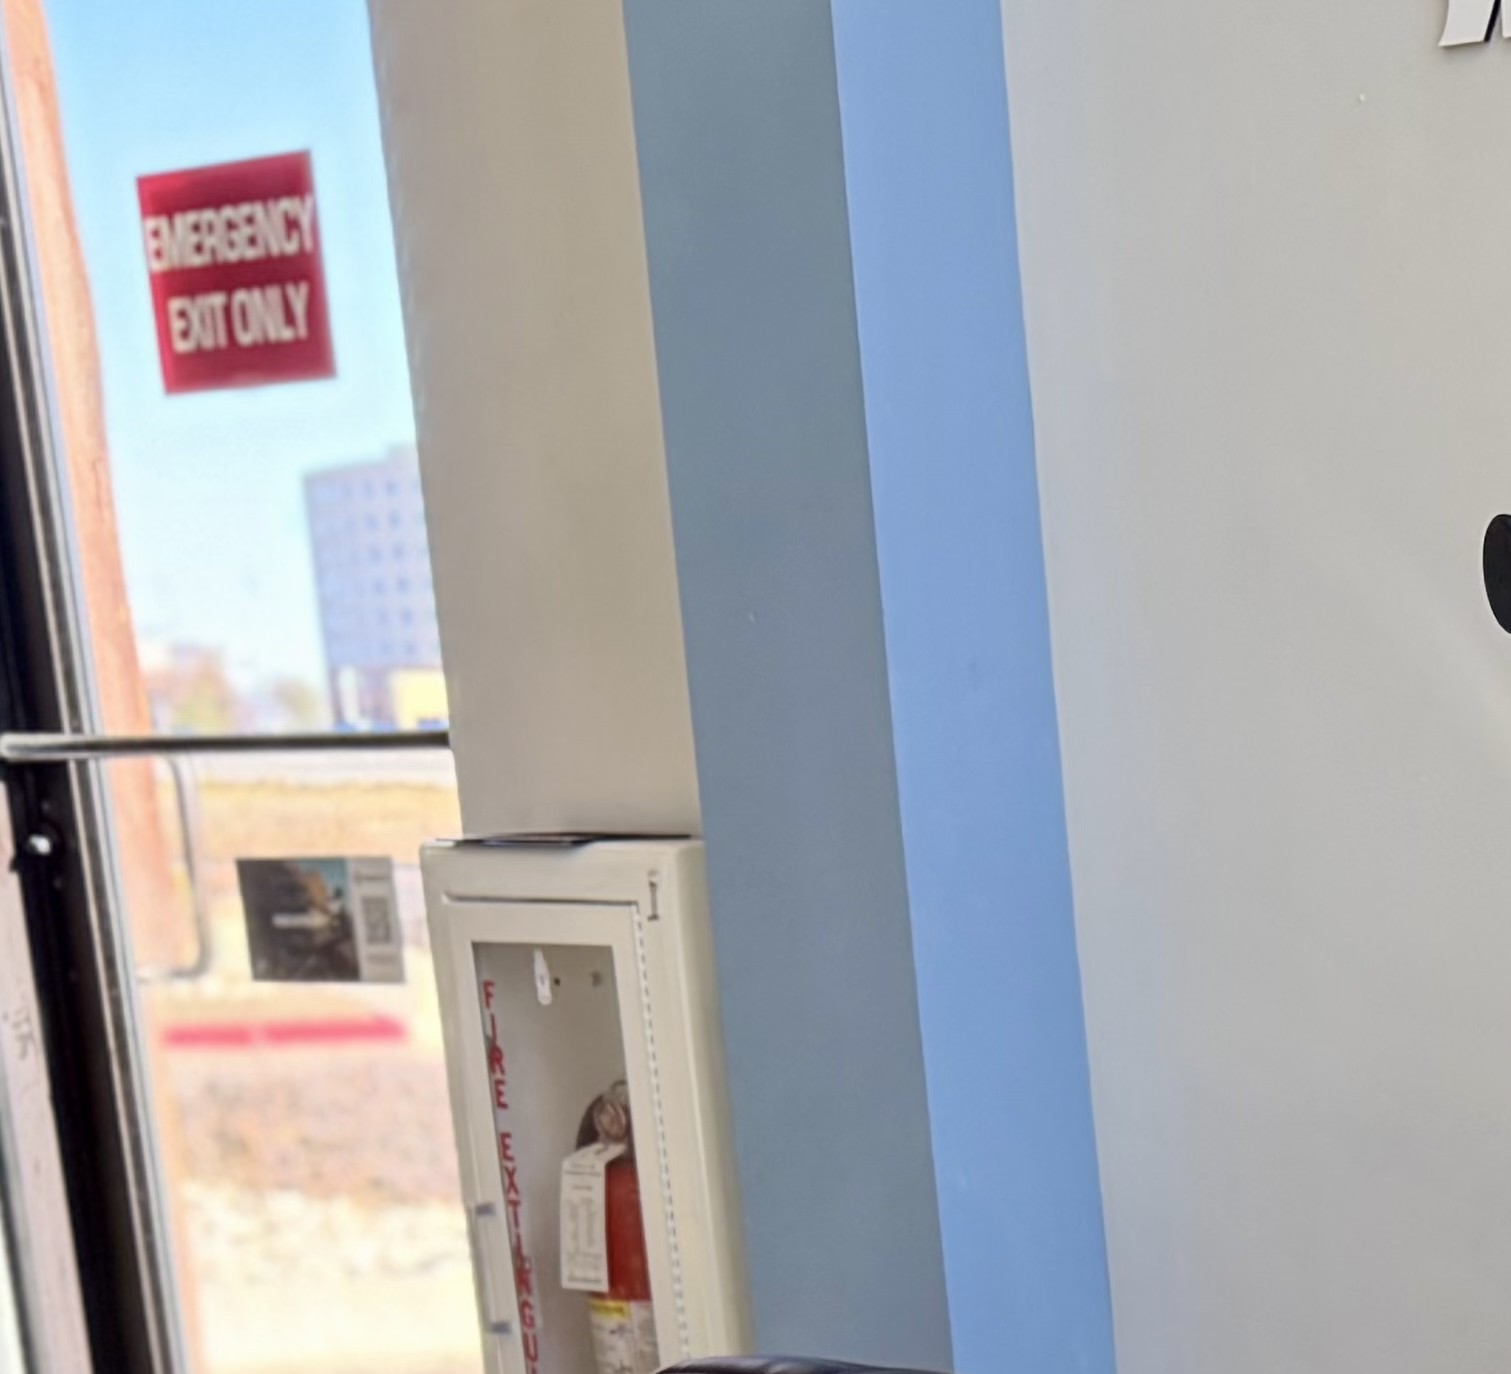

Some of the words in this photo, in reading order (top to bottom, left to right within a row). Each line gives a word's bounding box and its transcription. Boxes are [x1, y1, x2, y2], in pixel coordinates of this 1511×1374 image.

[143, 194, 314, 273] EMERGENCY
[167, 291, 228, 354] EXIT
[230, 281, 309, 347] ONLY
[483, 980, 509, 1110] FIRE
